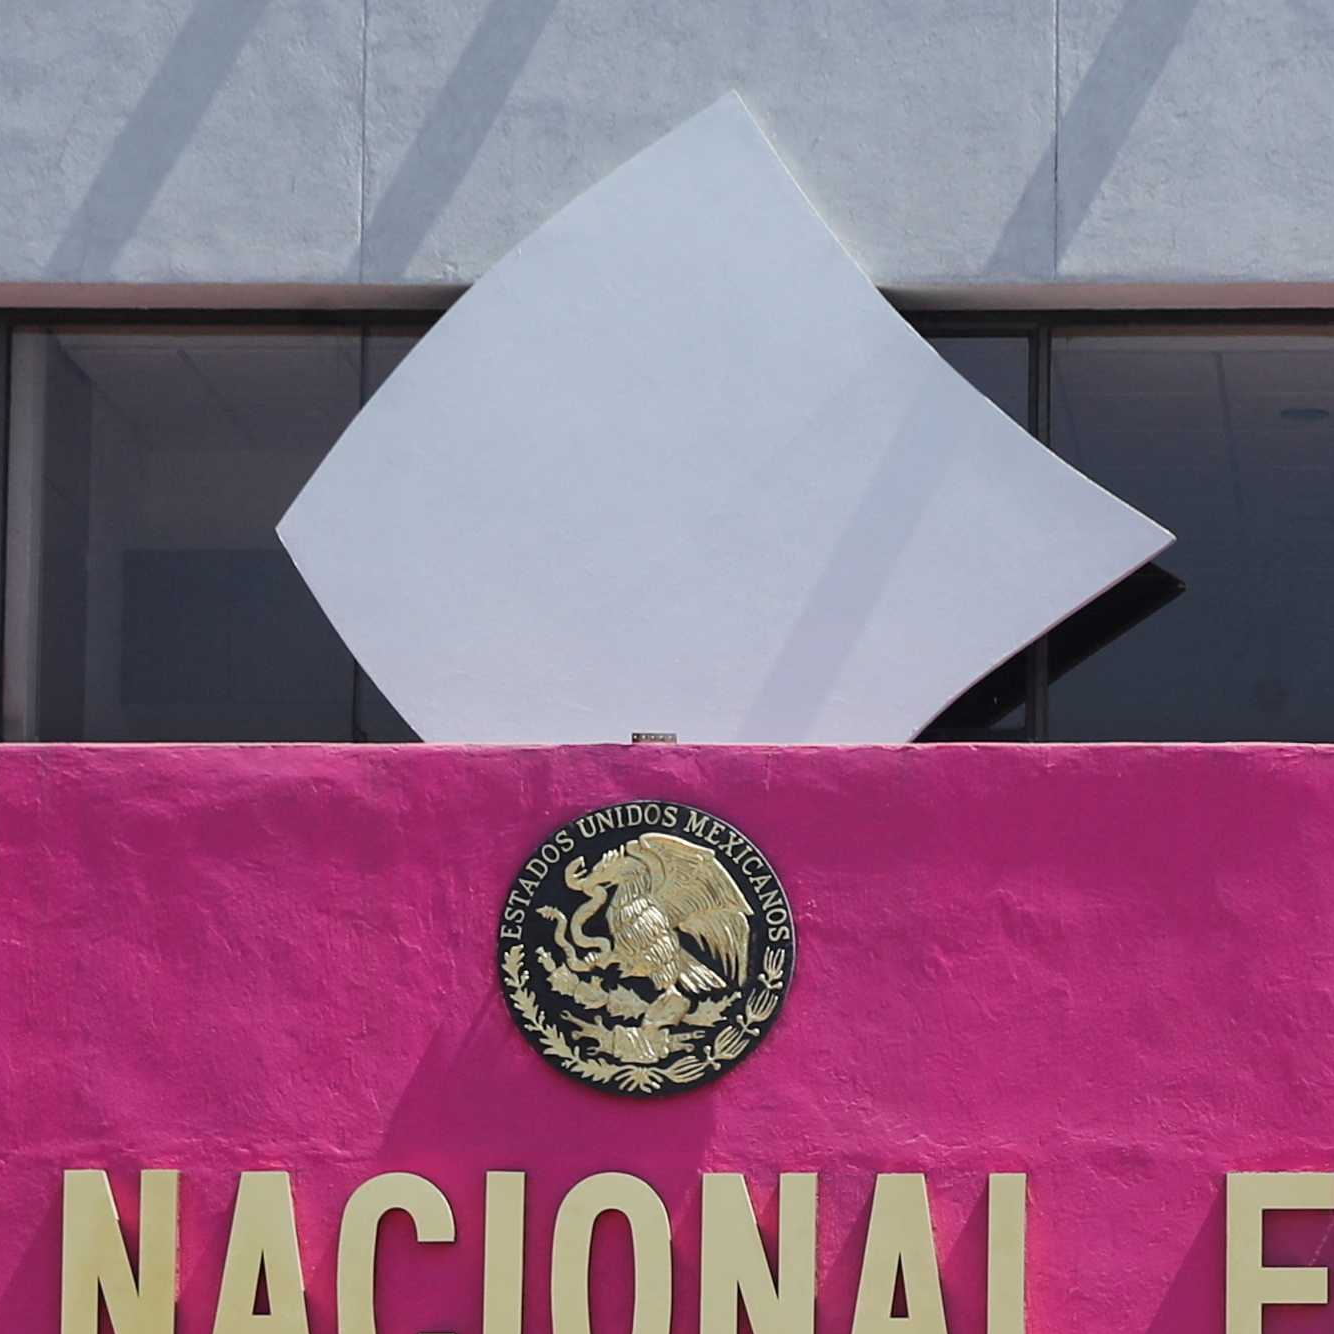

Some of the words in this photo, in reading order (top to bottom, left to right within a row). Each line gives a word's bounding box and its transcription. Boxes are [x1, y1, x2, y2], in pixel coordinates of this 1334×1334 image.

[500, 829, 575, 940] ESTADOS
[576, 803, 678, 840] UNIDOS
[683, 811, 791, 943] MEXICANOS
